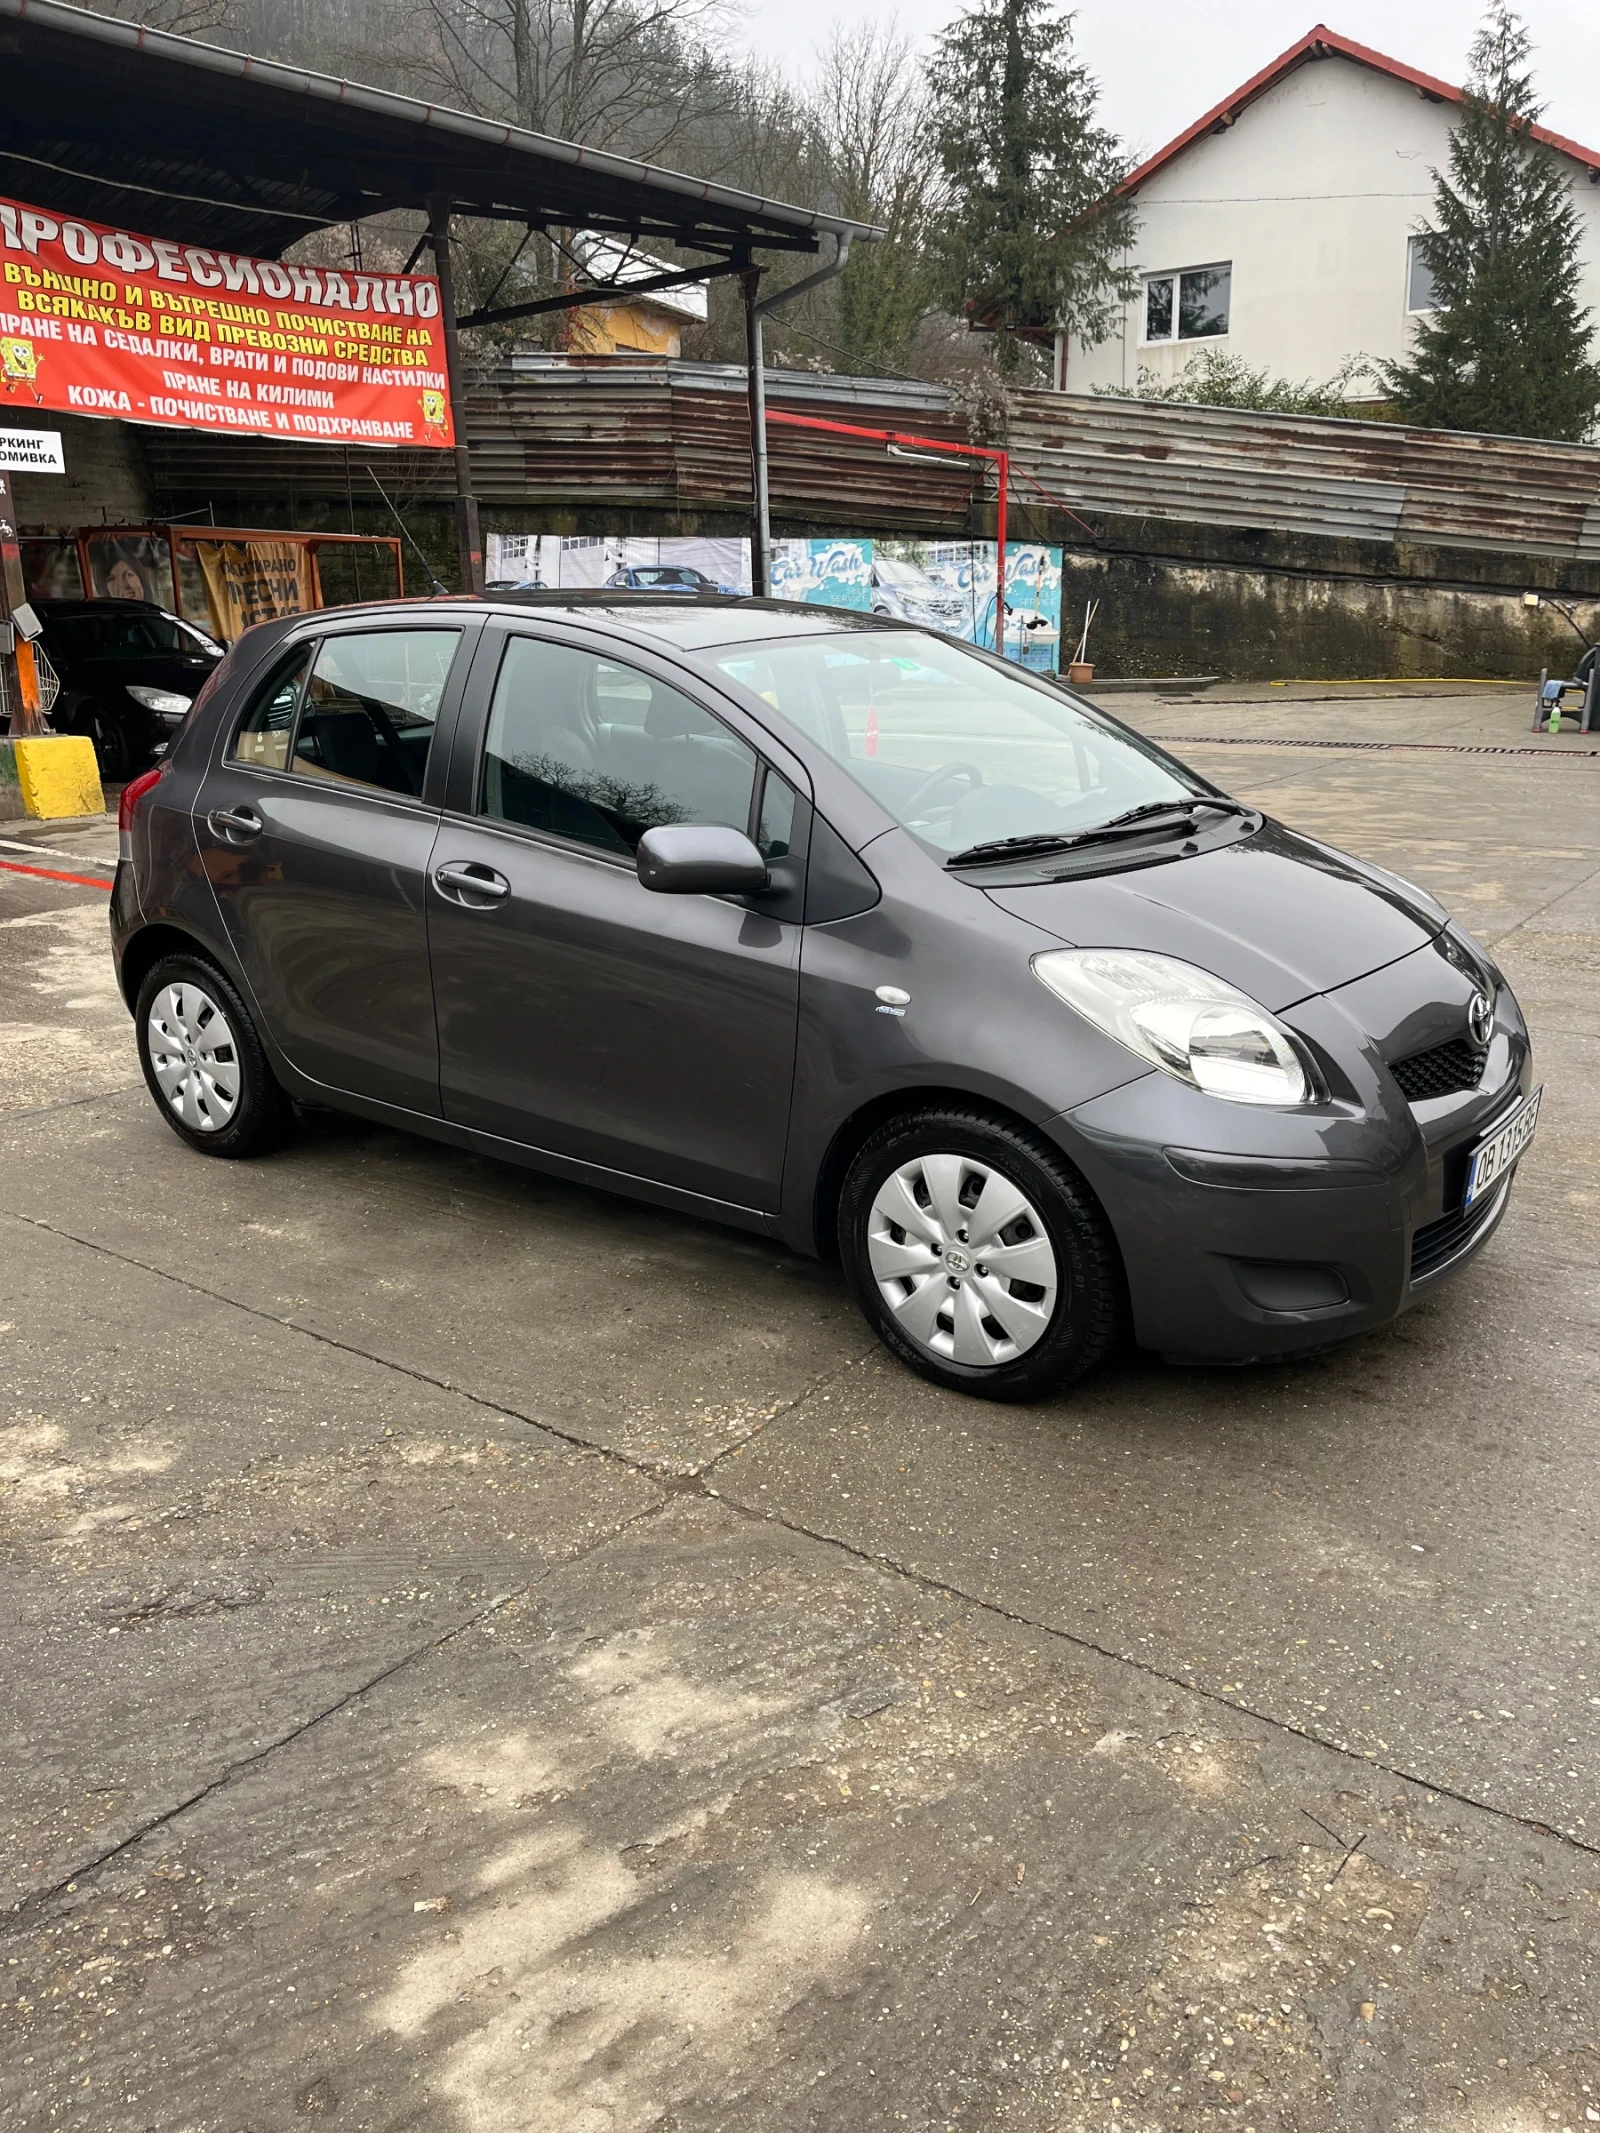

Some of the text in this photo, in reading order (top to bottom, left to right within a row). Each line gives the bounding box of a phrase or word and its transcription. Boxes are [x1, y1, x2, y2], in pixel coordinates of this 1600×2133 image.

[4, 262, 433, 347] ВЪНШНО И ВЪТРЕШНО ПОЧИСТВАНЕ НА
[17, 289, 429, 367] ВСЯКАКЪВ ВИД ПРЕВОЗНИ СРЕДСТВА
[67, 322, 98, 347] НА
[104, 328, 204, 366] СЕДАЛКИ,
[210, 346, 269, 372] ВРАТИ
[274, 354, 287, 375] И
[292, 358, 359, 382] ПОДОВИ
[362, 366, 446, 390] НАСТИЛКИ
[67, 385, 414, 440] КОЖА - ПОЧИСТВАНЕ И ПОДХРАНВАНЕ
[162, 370, 335, 409] ПРАНЕ НА КИЛИМИ
[771, 550, 862, 586] Car Wash
[846, 587, 867, 595] SELF
[830, 595, 868, 603] SERVICE
